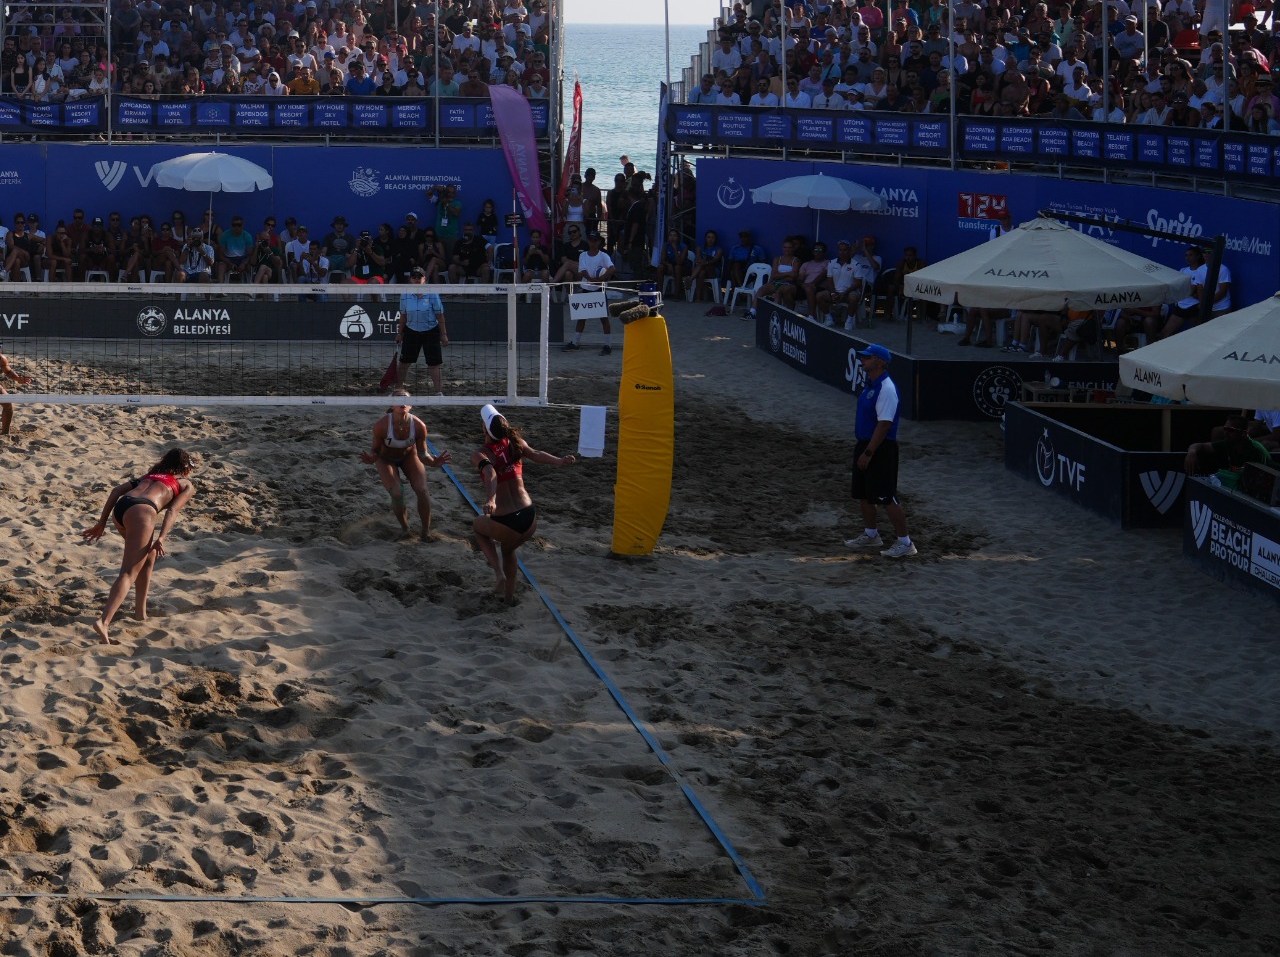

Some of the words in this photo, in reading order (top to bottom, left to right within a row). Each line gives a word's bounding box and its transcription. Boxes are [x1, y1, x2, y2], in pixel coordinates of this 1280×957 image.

[384, 183, 406, 191] BEACH
[874, 187, 918, 203] ANYA
[984, 267, 1050, 279] ALANYA
[915, 283, 942, 297] ALANYA
[1094, 291, 1141, 304] ALANYA
[581, 301, 604, 309] VBTV
[173, 308, 231, 321] ALANYA
[377, 310, 400, 322] ALA
[173, 322, 231, 335] BELEDİYESİ
[783, 319, 806, 345] ALANYA
[782, 342, 807, 365] BELEDİYESİ
[1222, 351, 1280, 364] ALAN
[1134, 368, 1162, 387] ALANYA
[1057, 454, 1086, 491] TVF
[1211, 519, 1251, 557] BEACH
[1210, 541, 1227, 560] PRO
[1227, 550, 1249, 573] TOUR
[1258, 546, 1280, 566] ALANY
[1255, 566, 1280, 586] CHALLEN
